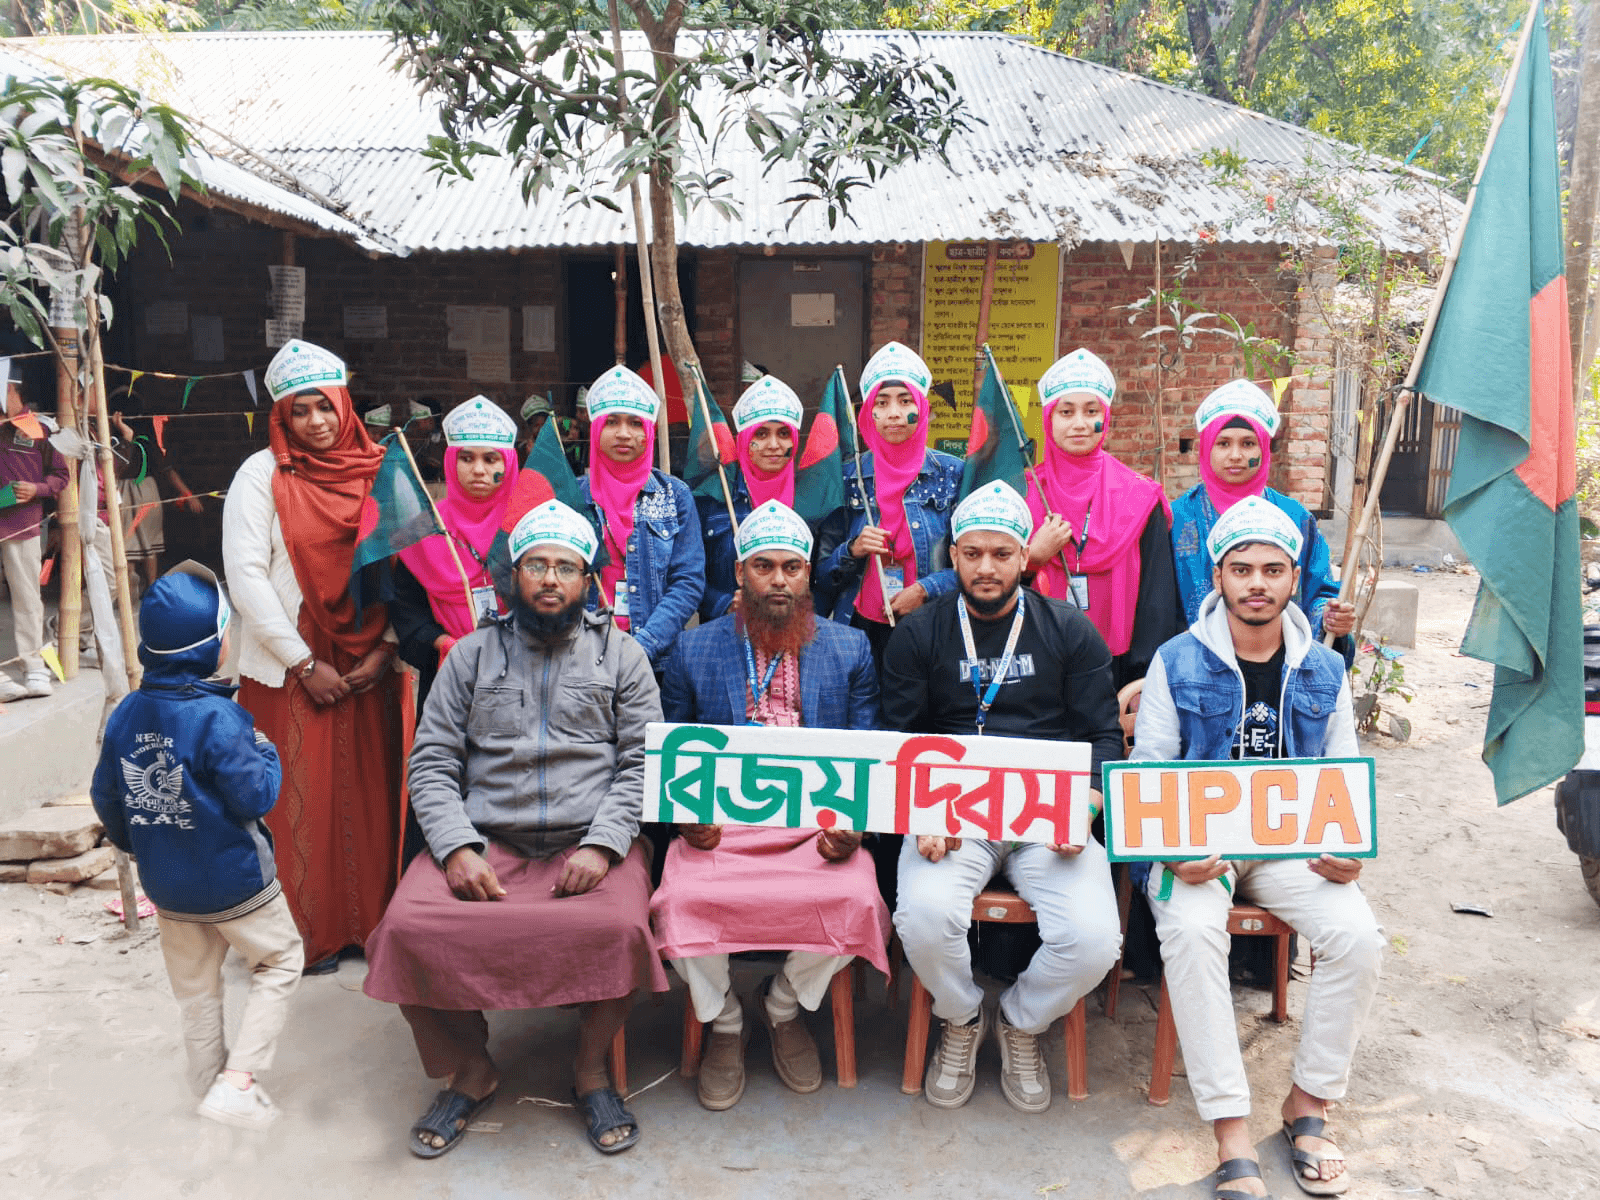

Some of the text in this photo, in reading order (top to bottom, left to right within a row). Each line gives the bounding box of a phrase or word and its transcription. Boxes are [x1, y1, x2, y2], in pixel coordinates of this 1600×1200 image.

[134, 732, 174, 748] NEVR
[645, 725, 1091, 845] বিজয় দিবস
[1121, 768, 1363, 848] HPCA
